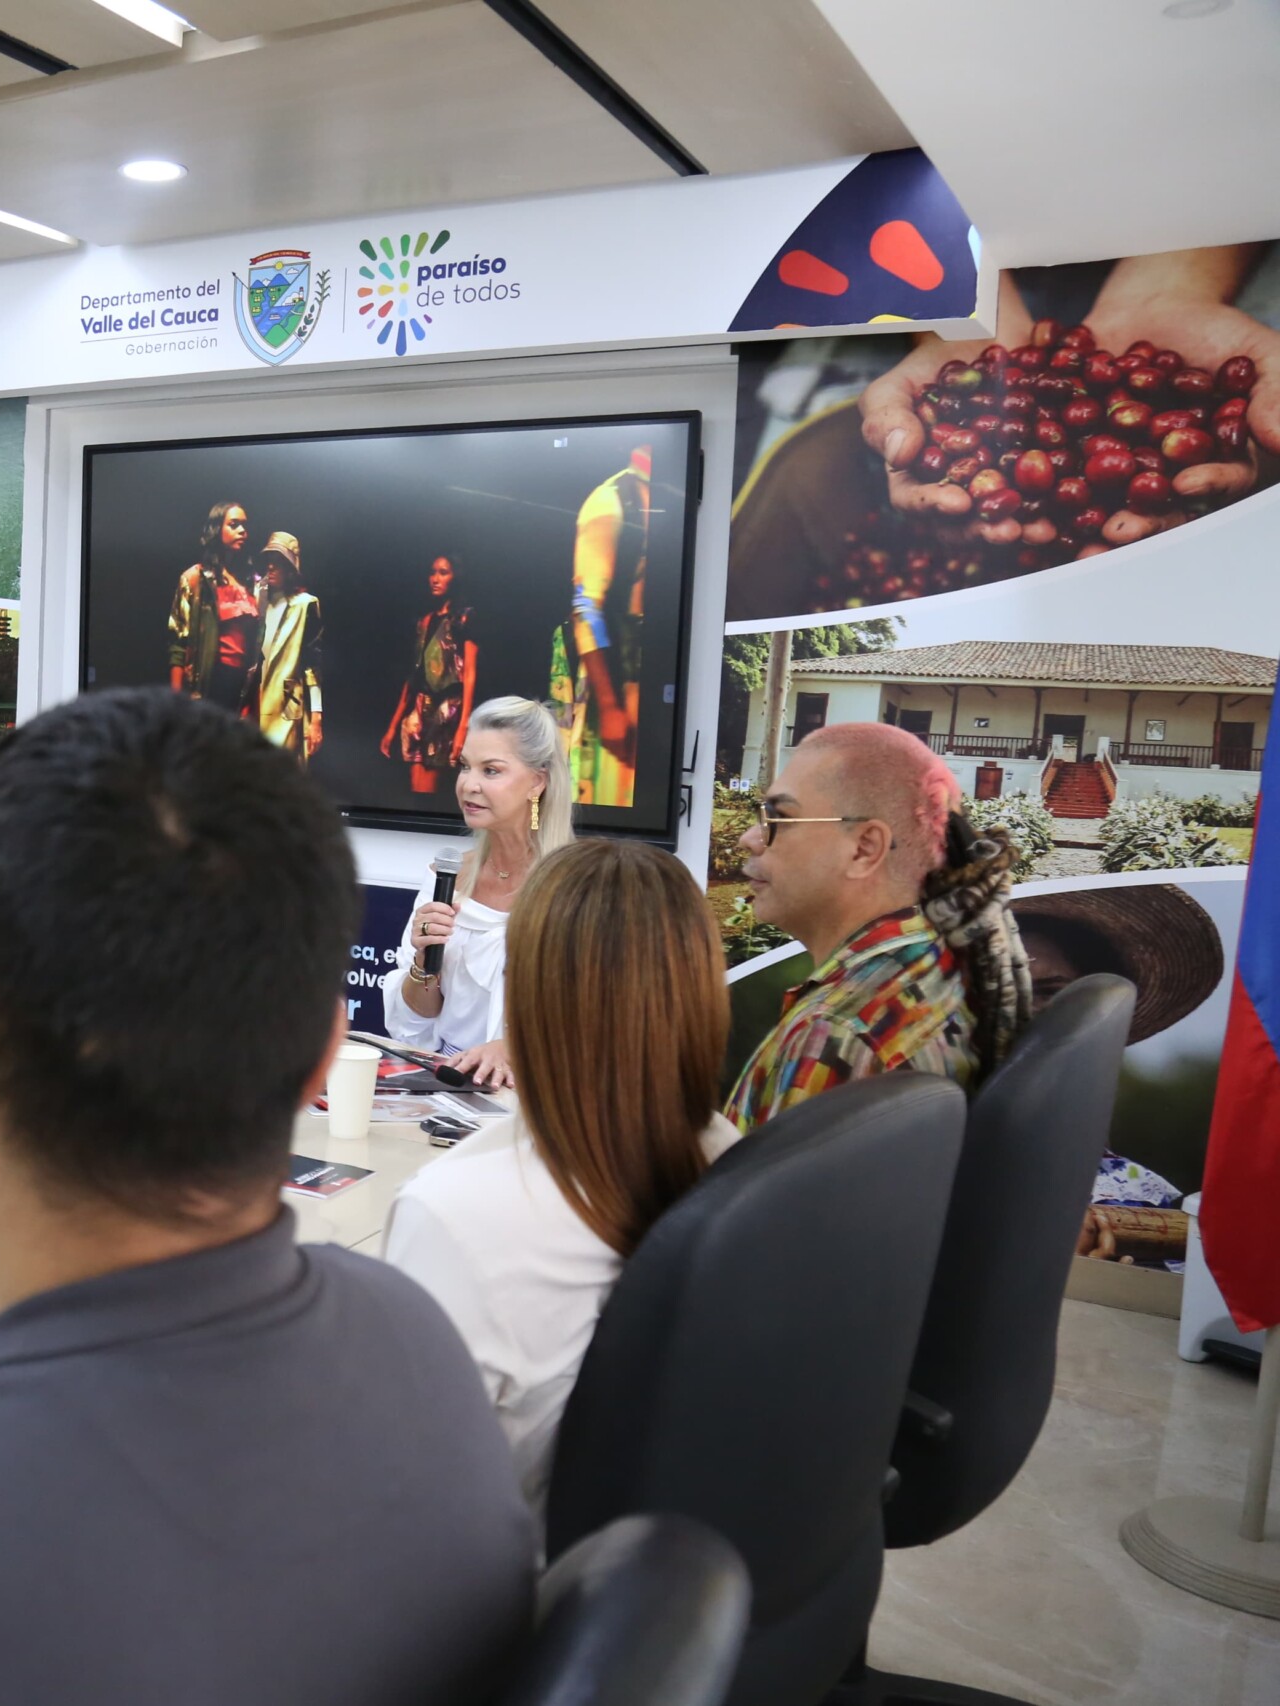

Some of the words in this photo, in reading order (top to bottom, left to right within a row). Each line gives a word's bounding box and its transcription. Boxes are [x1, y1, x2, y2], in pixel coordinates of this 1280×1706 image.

[417, 254, 507, 286] paraíso
[81, 285, 192, 311] Departamento
[196, 279, 220, 297] del
[416, 285, 445, 307] de
[453, 279, 521, 304] todos
[80, 315, 123, 335] Valle
[128, 310, 156, 330] del
[160, 308, 219, 326] Cauca
[125, 336, 218, 356] Gobernación
[350, 944, 380, 965] ca,
